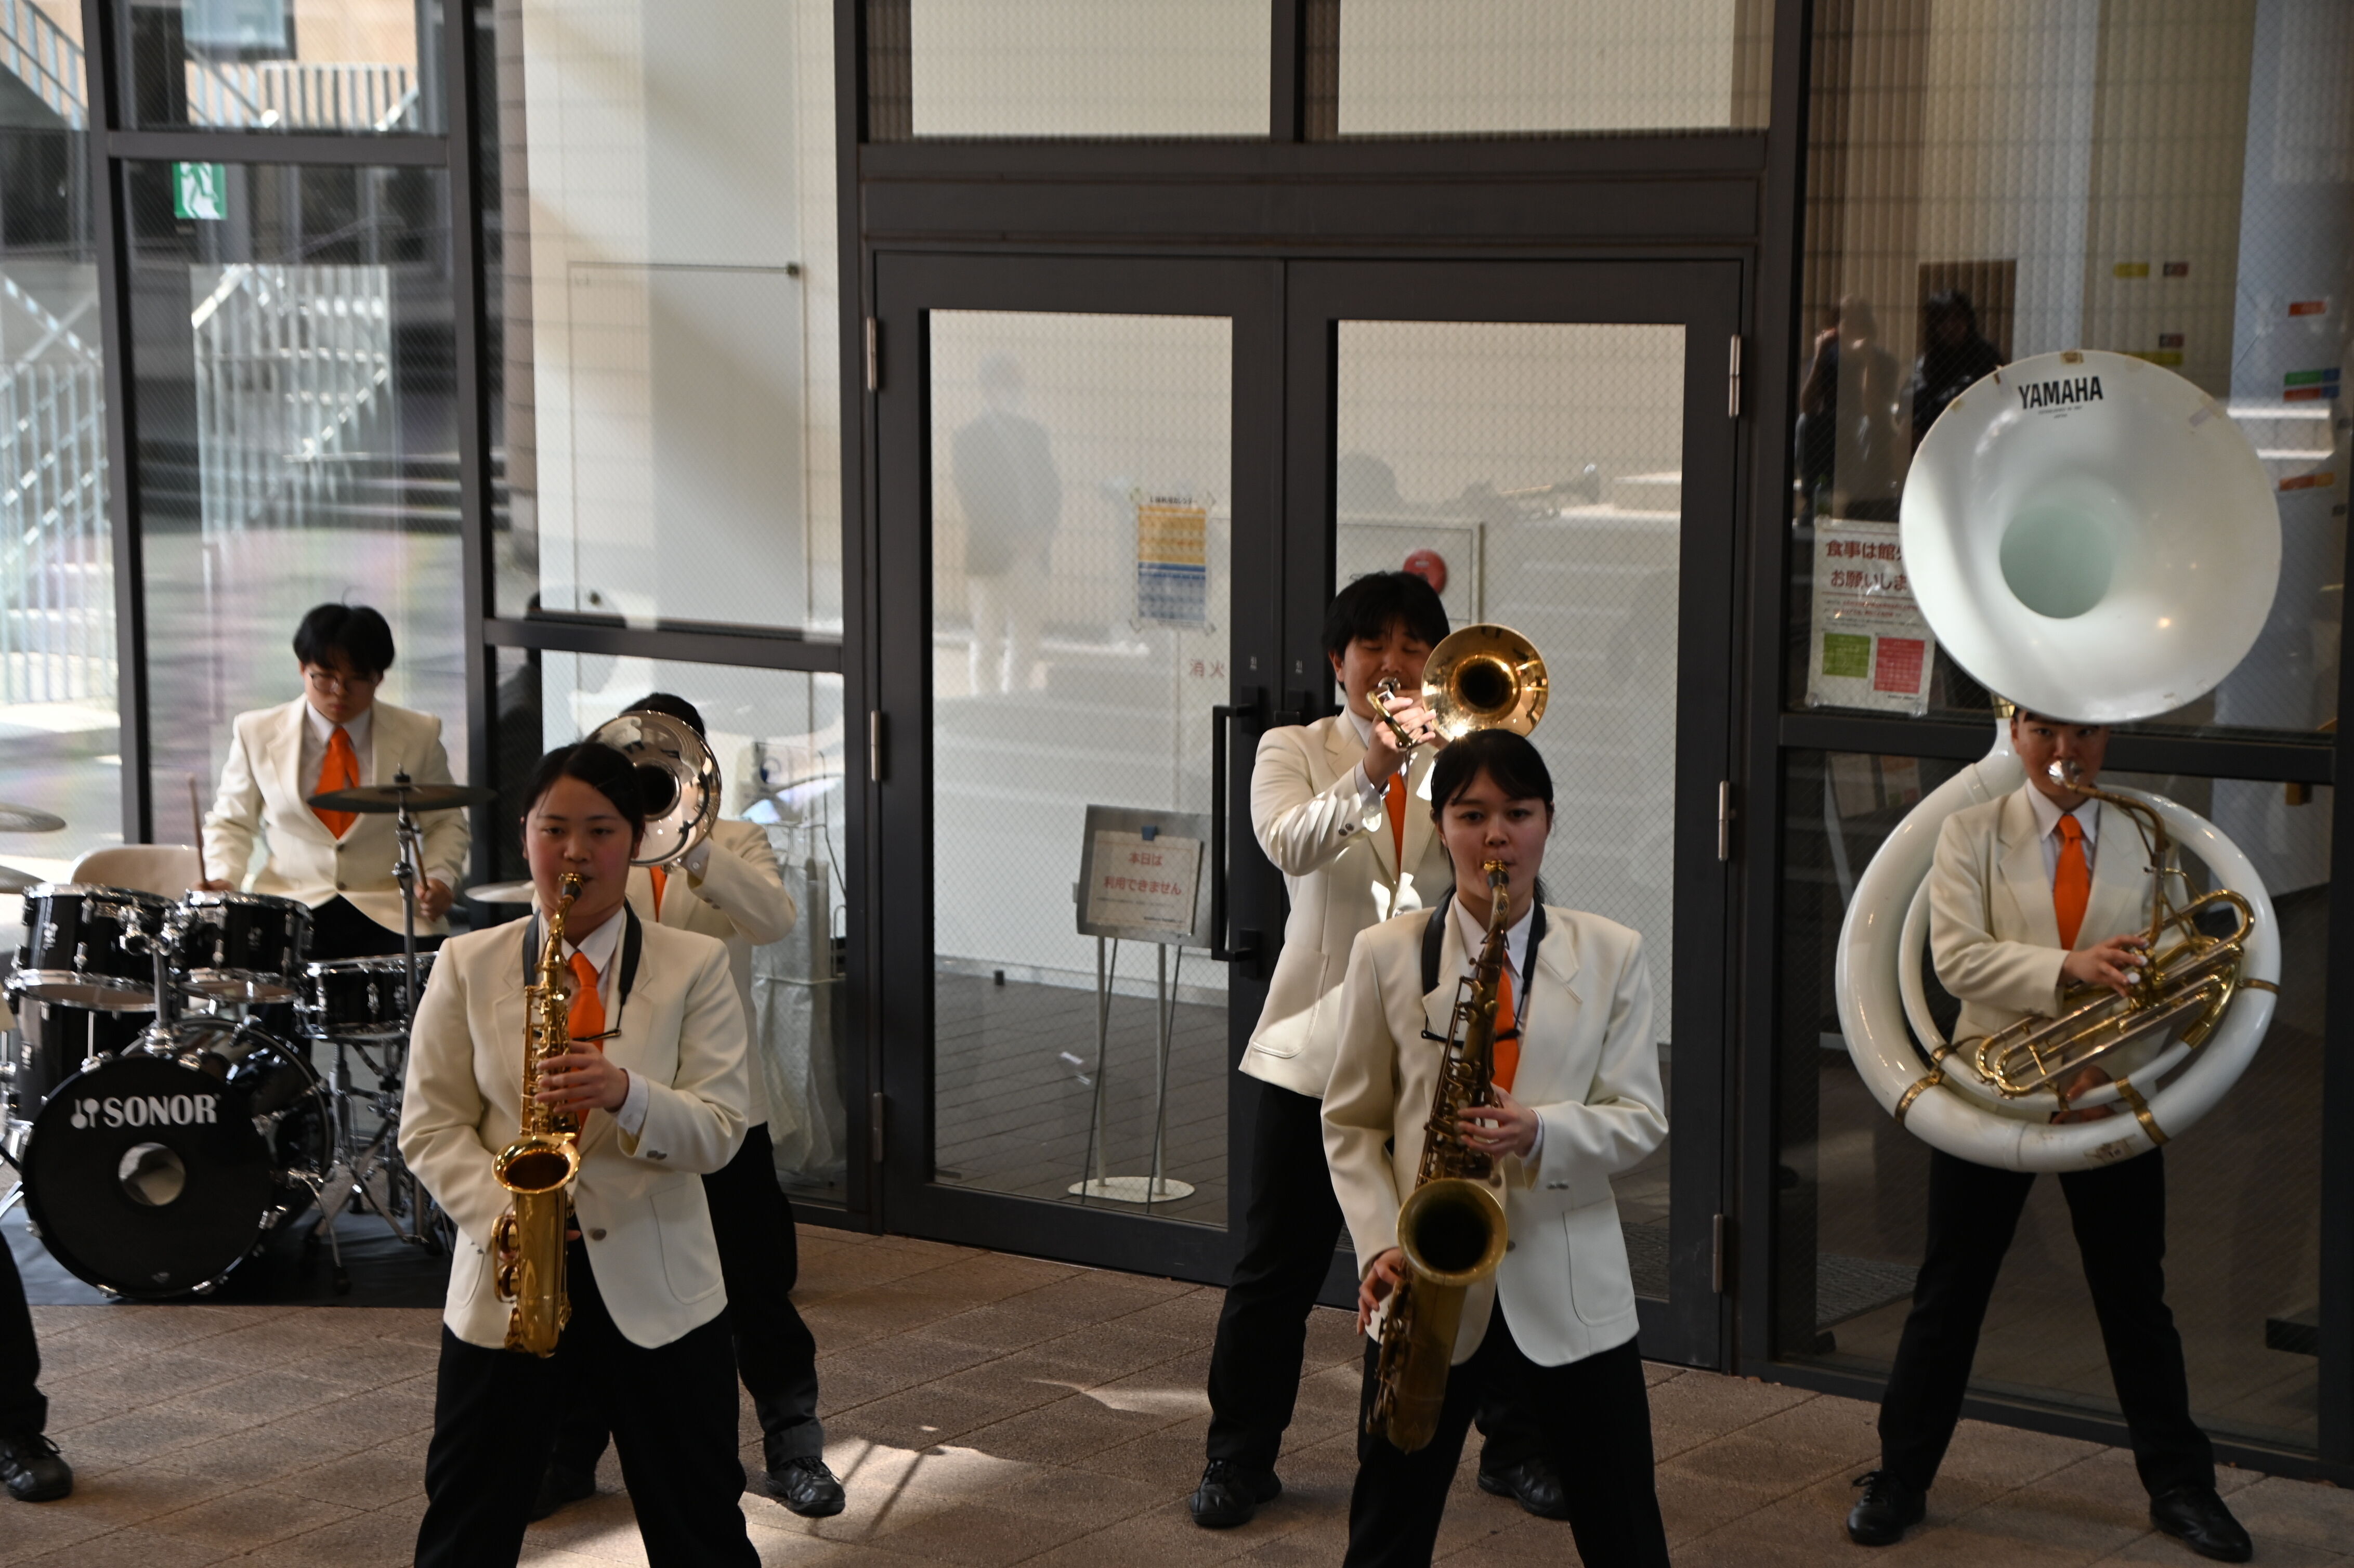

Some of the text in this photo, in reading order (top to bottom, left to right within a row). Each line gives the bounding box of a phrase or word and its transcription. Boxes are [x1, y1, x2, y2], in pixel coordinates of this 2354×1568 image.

[2018, 376, 2103, 409] YAMAHA
[1129, 853, 1162, 866] 本日は
[1104, 876, 1181, 895] 利用できません
[103, 1094, 217, 1128] SONOR
